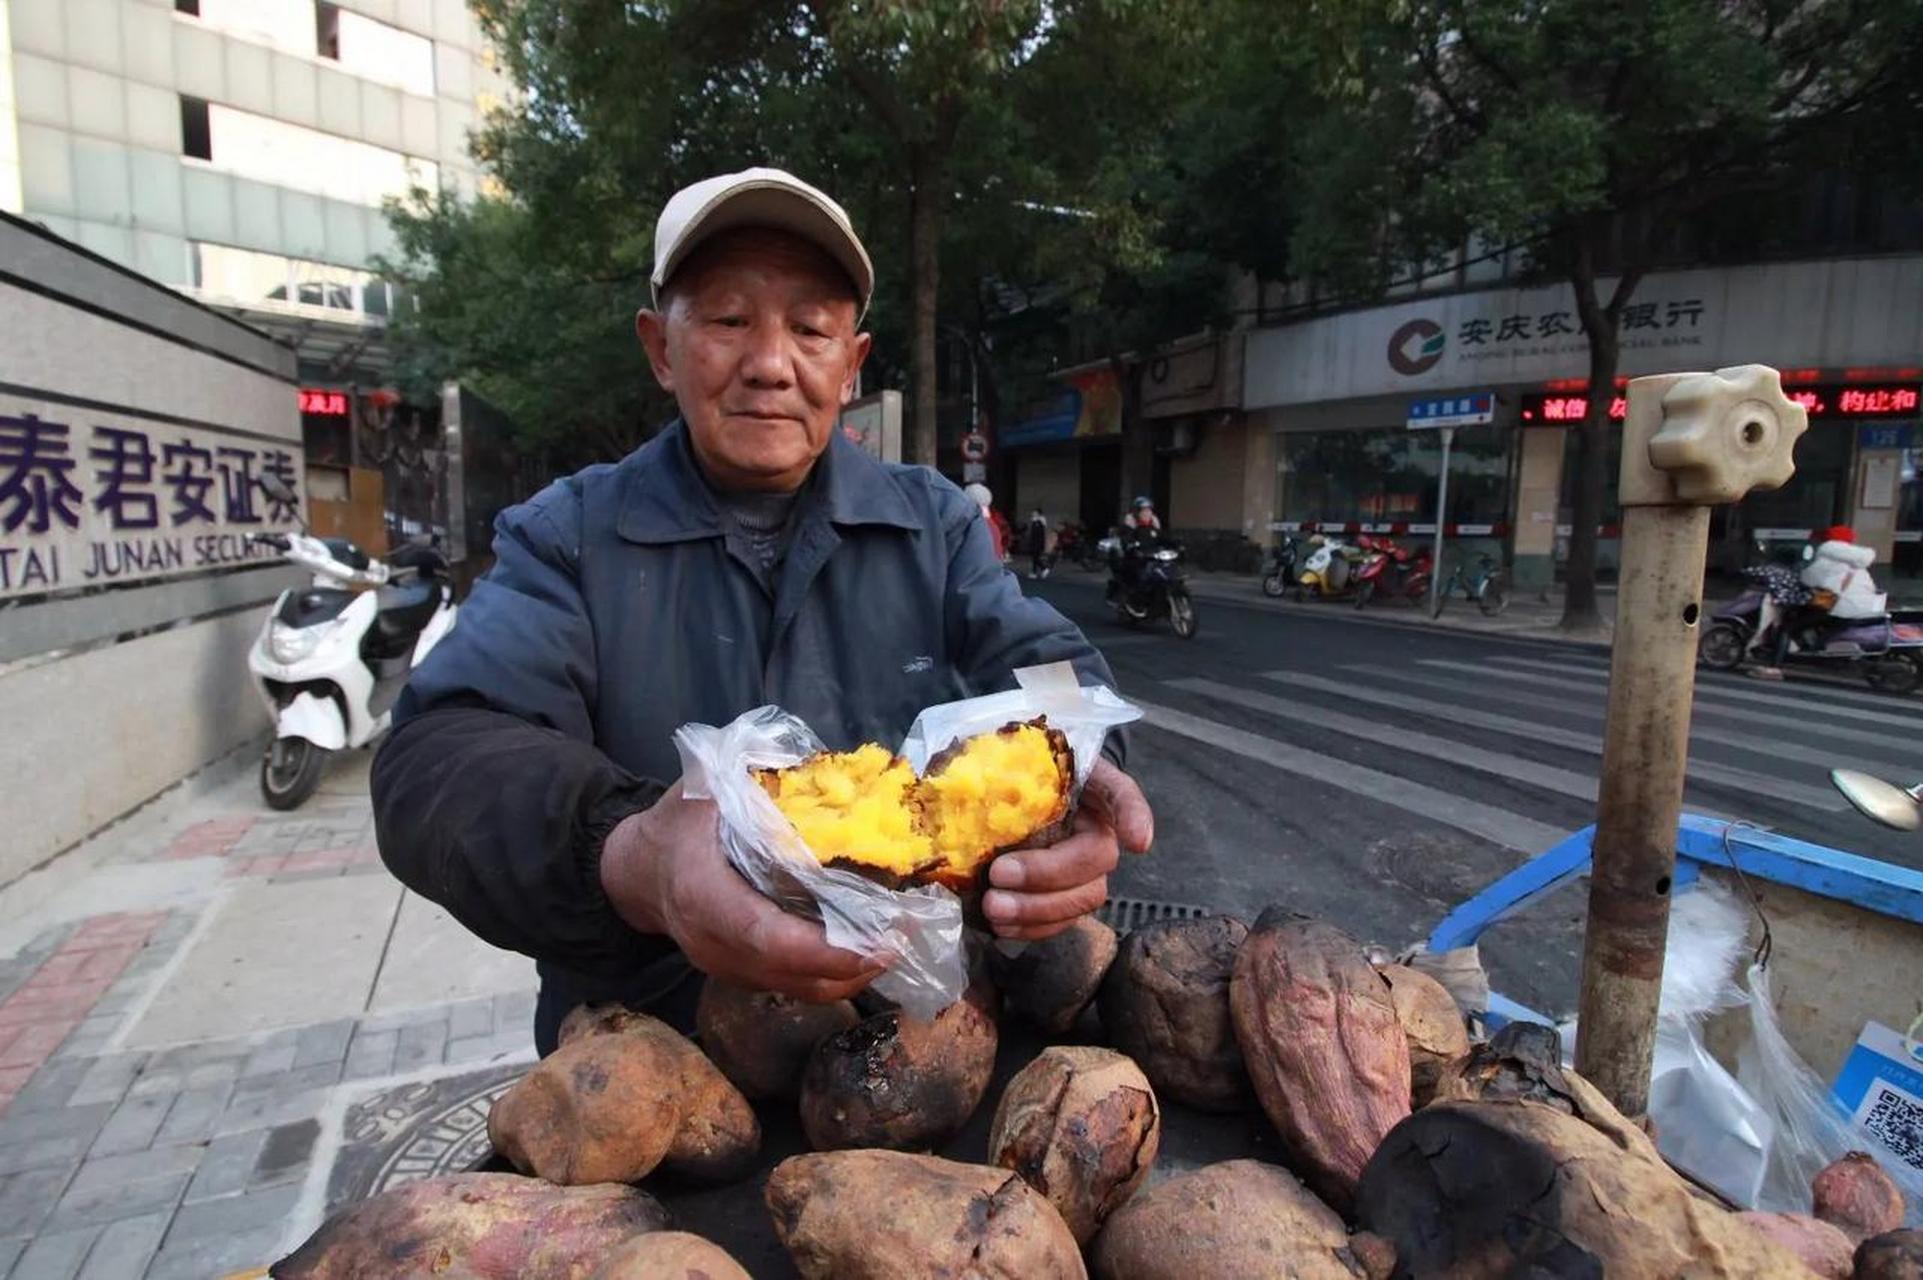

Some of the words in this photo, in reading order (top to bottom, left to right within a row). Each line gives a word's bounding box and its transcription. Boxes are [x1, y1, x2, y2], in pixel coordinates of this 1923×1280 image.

[1458, 300, 1705, 346] 安庆农银行
[83, 537, 183, 578] JUNAN
